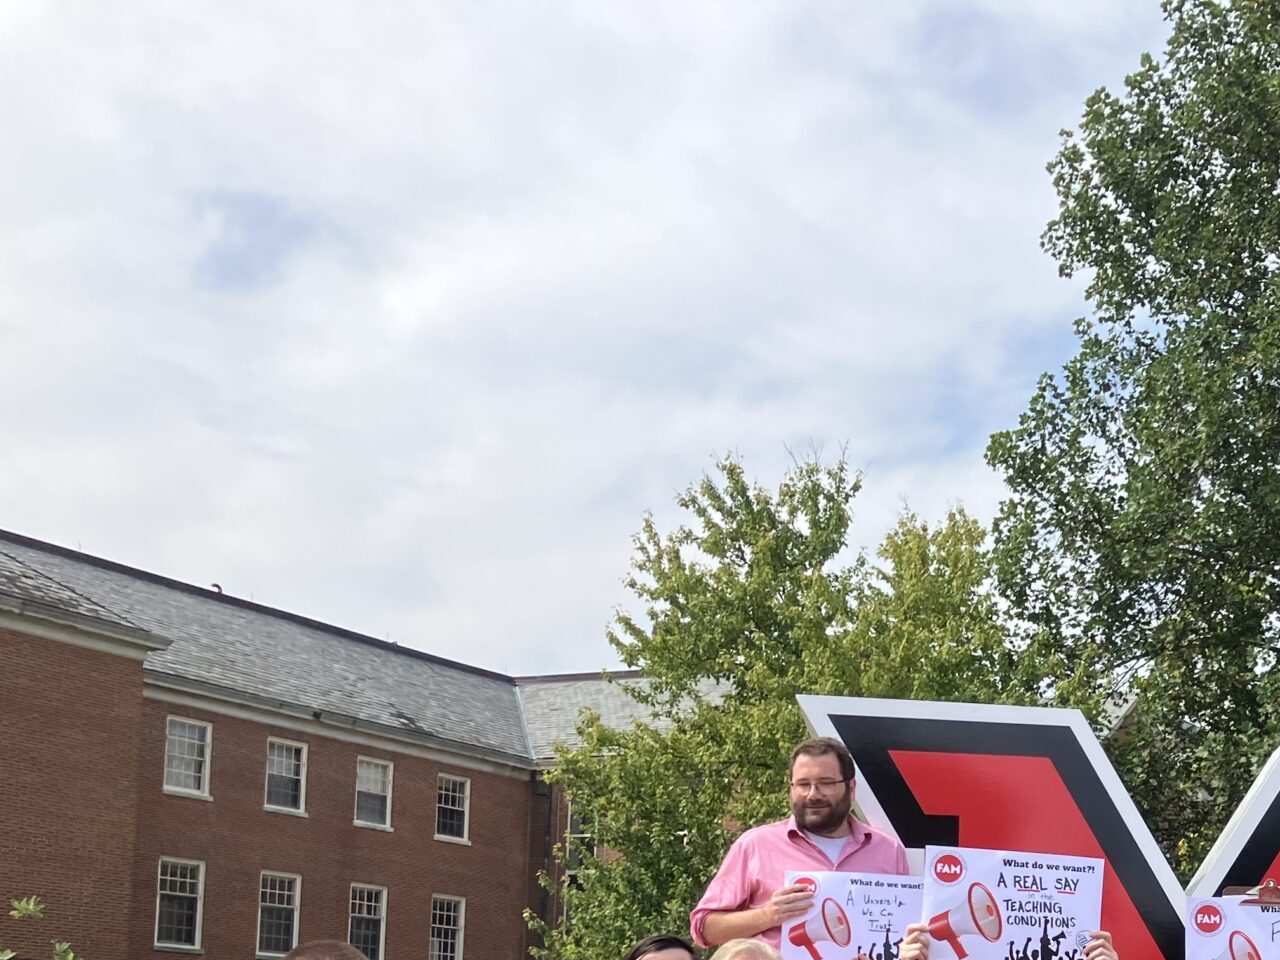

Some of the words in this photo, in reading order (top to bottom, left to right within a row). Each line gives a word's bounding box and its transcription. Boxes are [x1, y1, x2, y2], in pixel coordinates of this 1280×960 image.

[936, 864, 961, 874] FAM
[1002, 858, 1029, 869] What
[1032, 861, 1044, 869] do
[1062, 865, 1095, 874] want?!
[998, 872, 1008, 888] A
[1014, 875, 1048, 891] REAL
[1055, 877, 1080, 892] SAY
[846, 890, 855, 907] A
[863, 908, 873, 916] We
[1003, 899, 1062, 915] TEACHING
[868, 920, 893, 930] Trust
[1007, 915, 1076, 929] CONDITIONS
[1197, 914, 1220, 924] FAM
